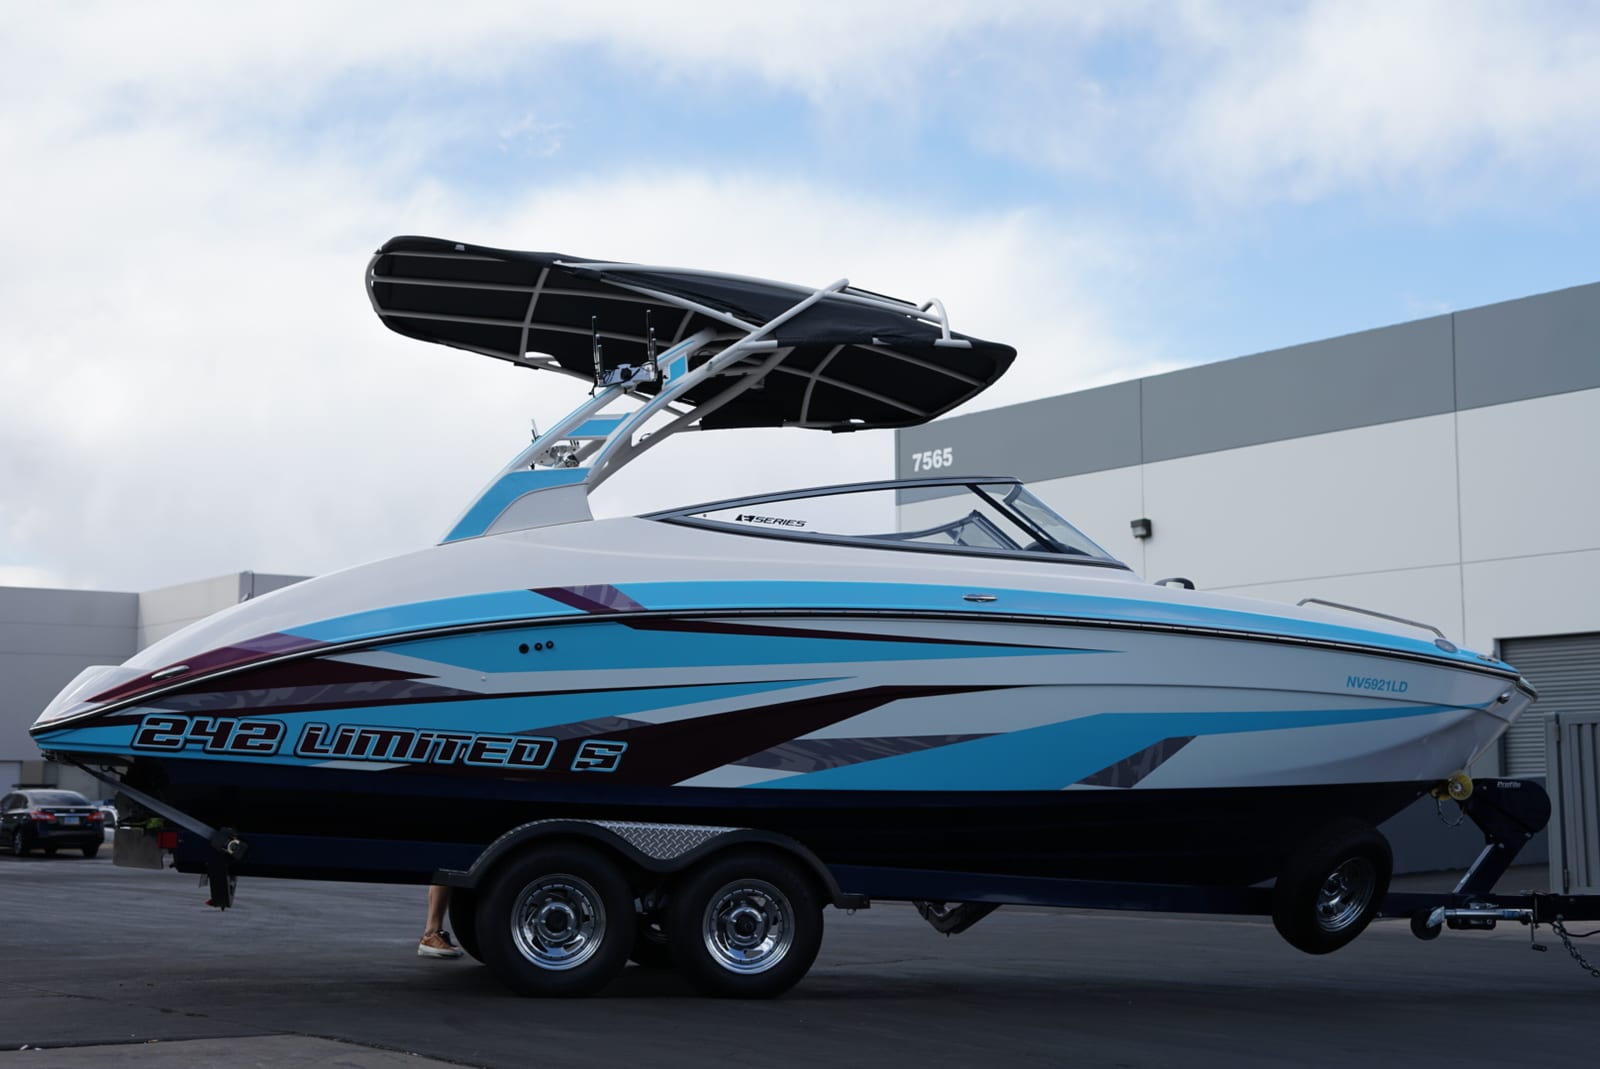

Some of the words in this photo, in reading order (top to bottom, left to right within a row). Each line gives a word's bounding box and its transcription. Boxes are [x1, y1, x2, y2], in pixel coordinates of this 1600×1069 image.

[912, 447, 953, 472] 7565
[753, 516, 807, 528] SERIES
[1346, 675, 1408, 693] NV5921LD
[131, 713, 286, 756] 242
[570, 739, 629, 773] S
